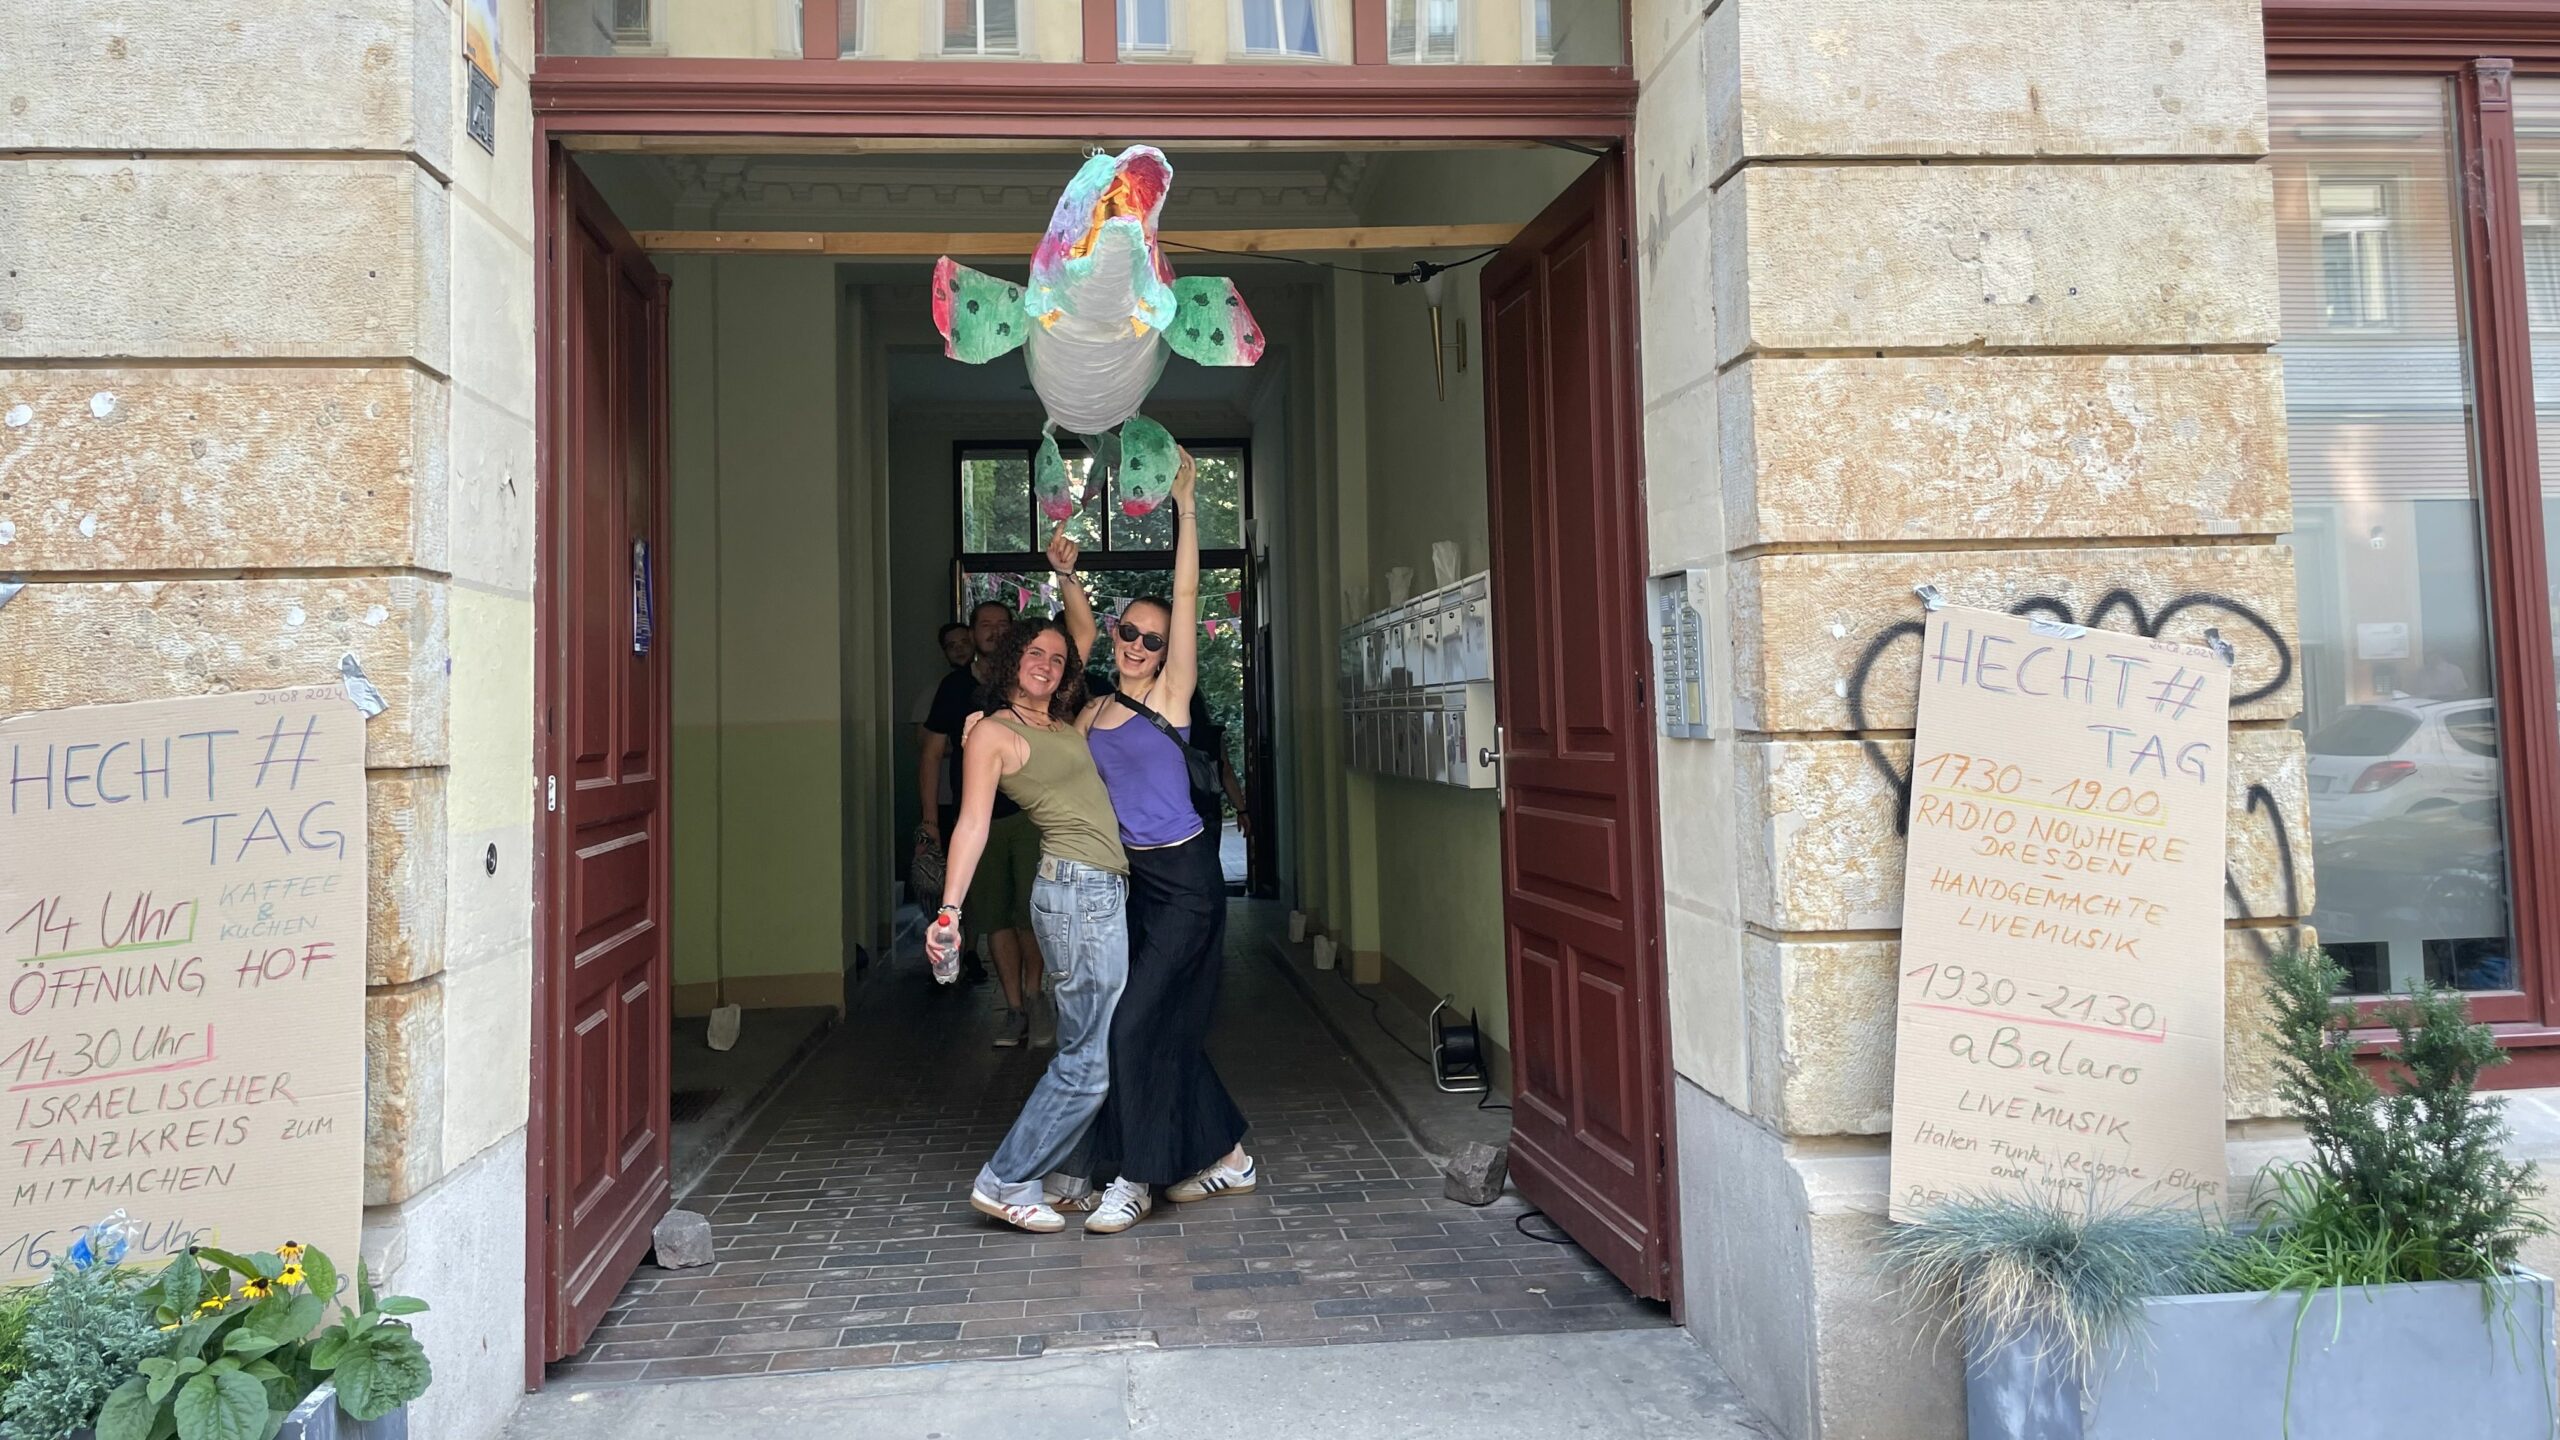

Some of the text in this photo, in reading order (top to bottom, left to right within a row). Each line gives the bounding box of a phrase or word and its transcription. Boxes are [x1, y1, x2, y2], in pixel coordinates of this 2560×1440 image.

[305, 687, 345, 701] 2024
[2087, 725, 2211, 785] TAG
[182, 801, 345, 865] TAG
[1916, 794, 2190, 863] RADIO NOWHERE
[1973, 835, 2132, 877] DRESDEN
[219, 874, 341, 906] KAFFEE
[1931, 866, 2168, 926] HANDGEMACHTE
[6, 889, 192, 957] 14 Uhr
[1958, 907, 2141, 961] LIVEMUSIK
[10, 942, 337, 1016] ÖFFNUNG HOF
[0, 1024, 196, 1082] 14.30 Uhr
[15, 1072, 299, 1130] ISRAELISCHER
[1958, 1089, 2131, 1145] LIVEMUSIK
[11, 1116, 334, 1168] TANZKREIS ZUM
[13, 1163, 236, 1207] MITMACHEN
[1991, 1164, 2027, 1180] and
